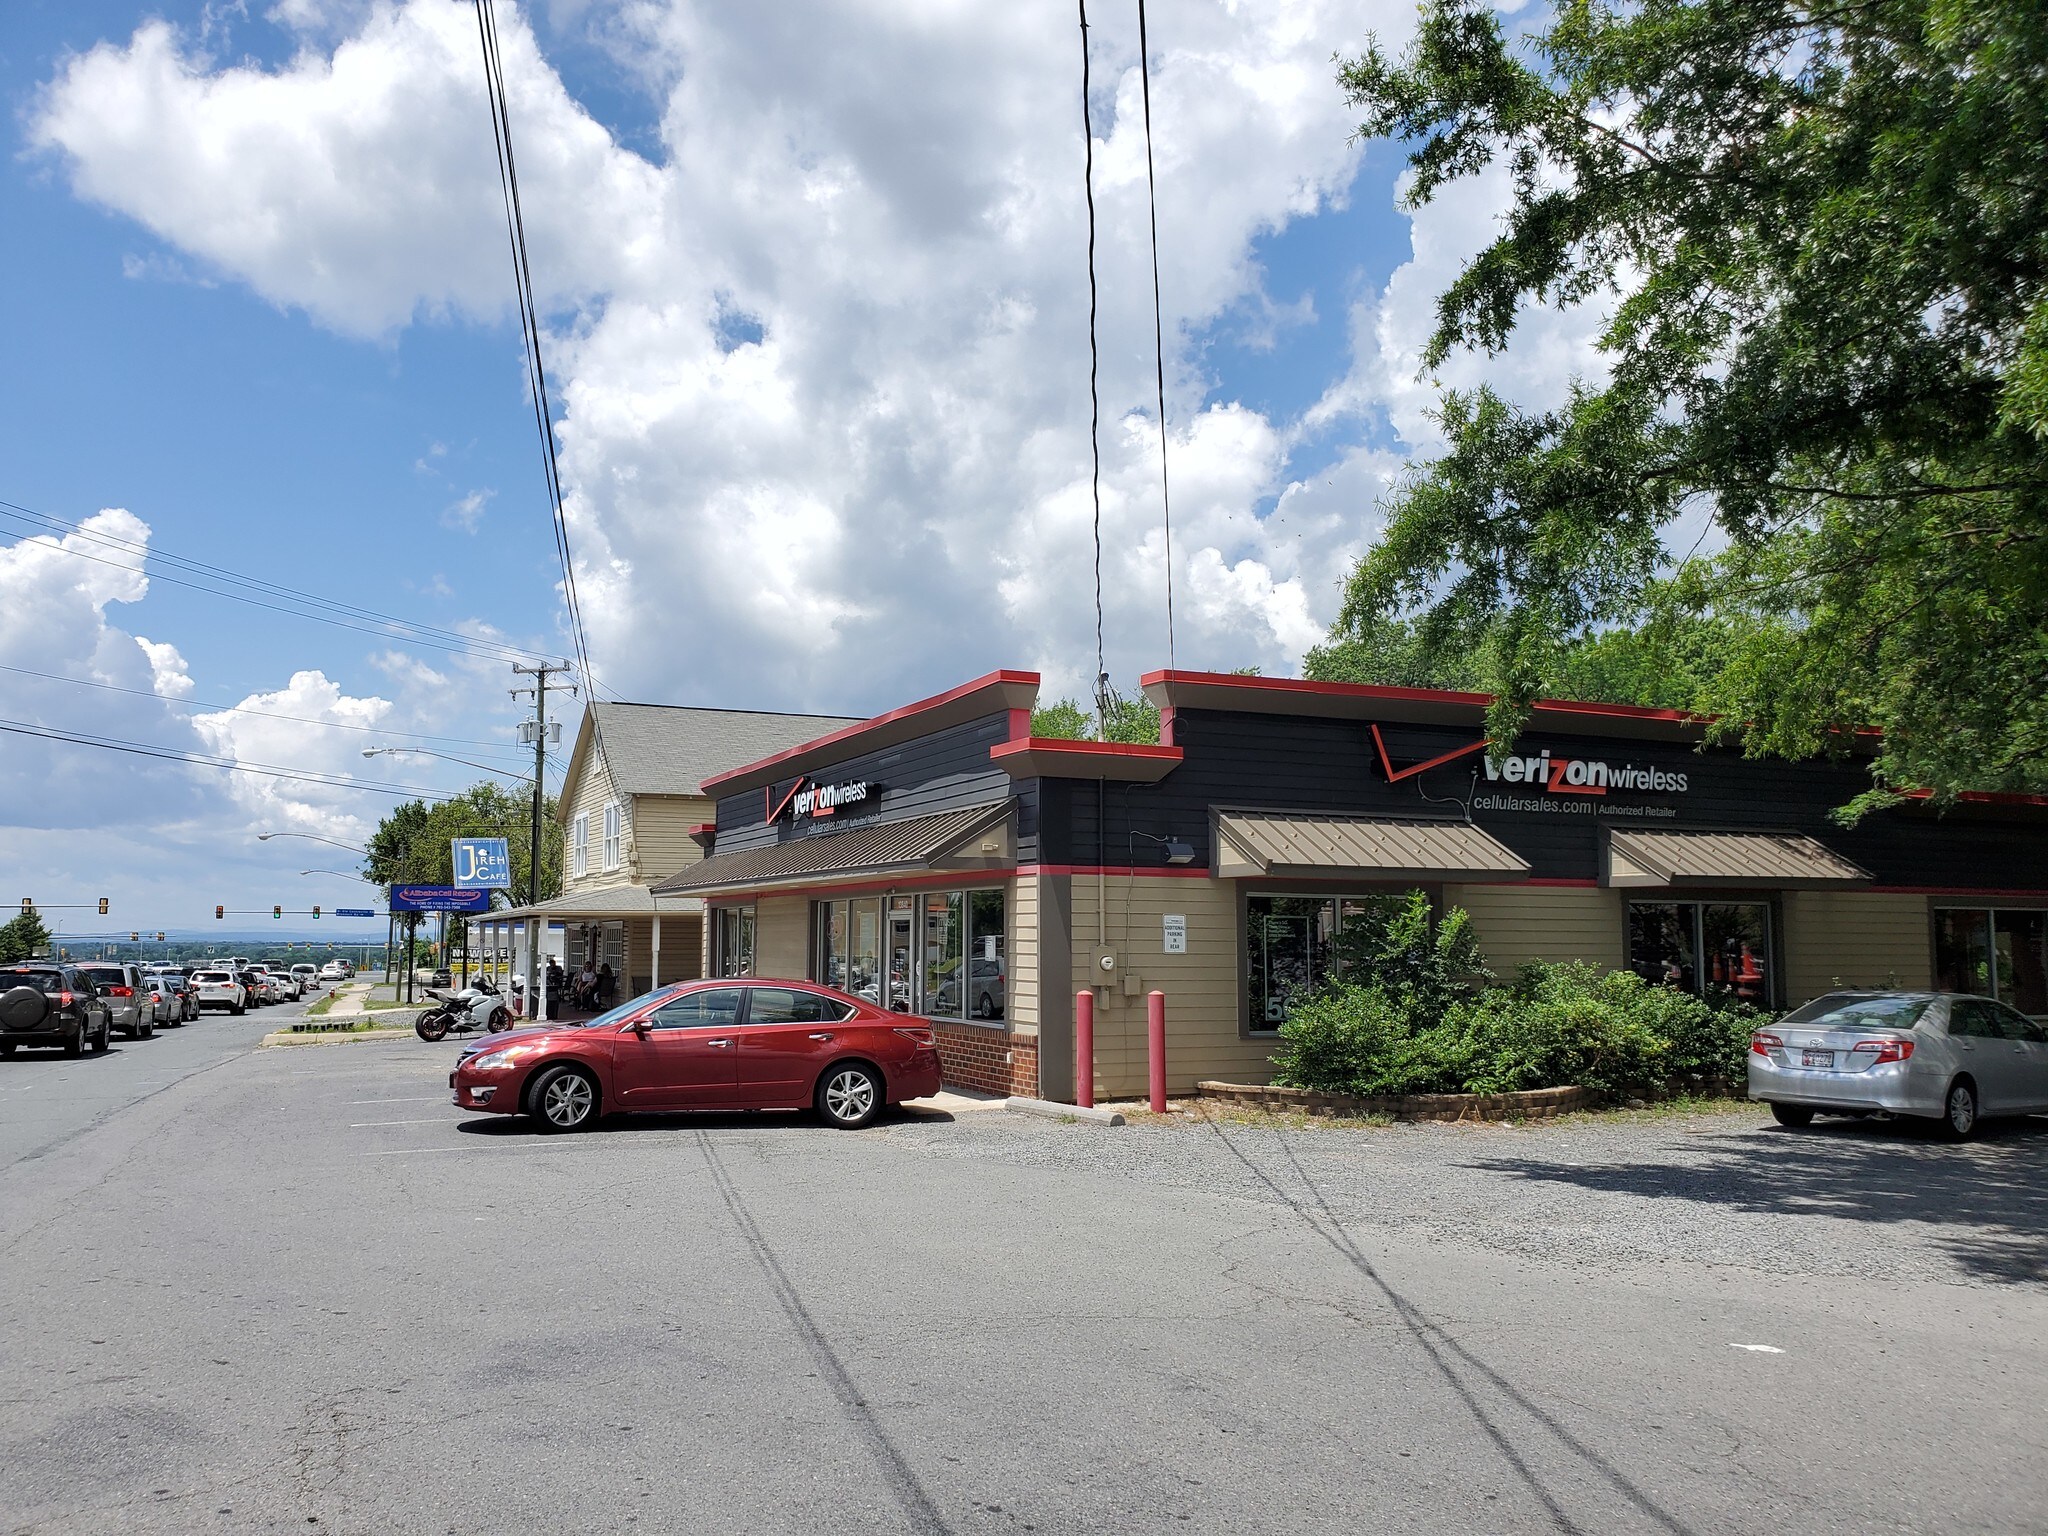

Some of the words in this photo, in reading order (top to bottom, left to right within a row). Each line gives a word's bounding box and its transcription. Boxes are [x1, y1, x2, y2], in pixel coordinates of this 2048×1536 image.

[1474, 795, 1591, 814] cellularsales.com
[1598, 804, 1643, 816] Authorized
[1645, 806, 1677, 817] Retailer
[807, 820, 848, 835] cellularsales.com
[452, 890, 476, 898] Repair
